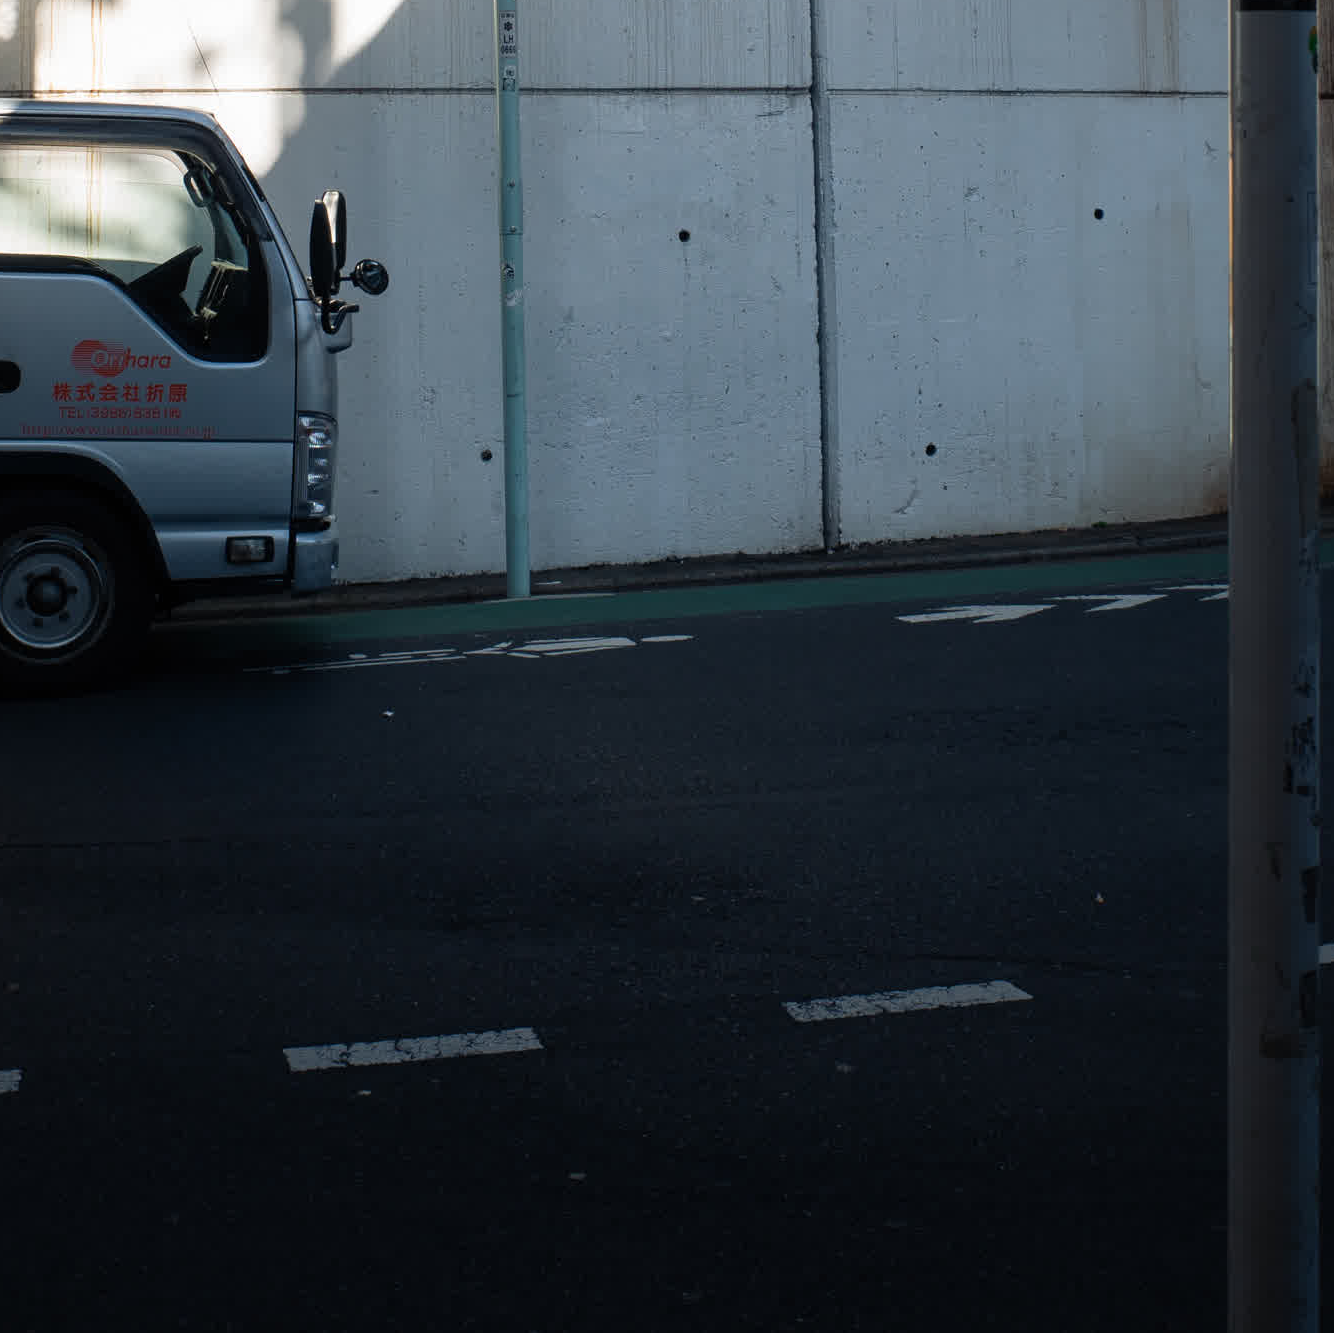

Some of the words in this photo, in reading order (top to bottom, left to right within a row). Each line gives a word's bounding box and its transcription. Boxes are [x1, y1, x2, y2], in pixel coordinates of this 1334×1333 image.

[52, 381, 188, 403] 株式会社折原
